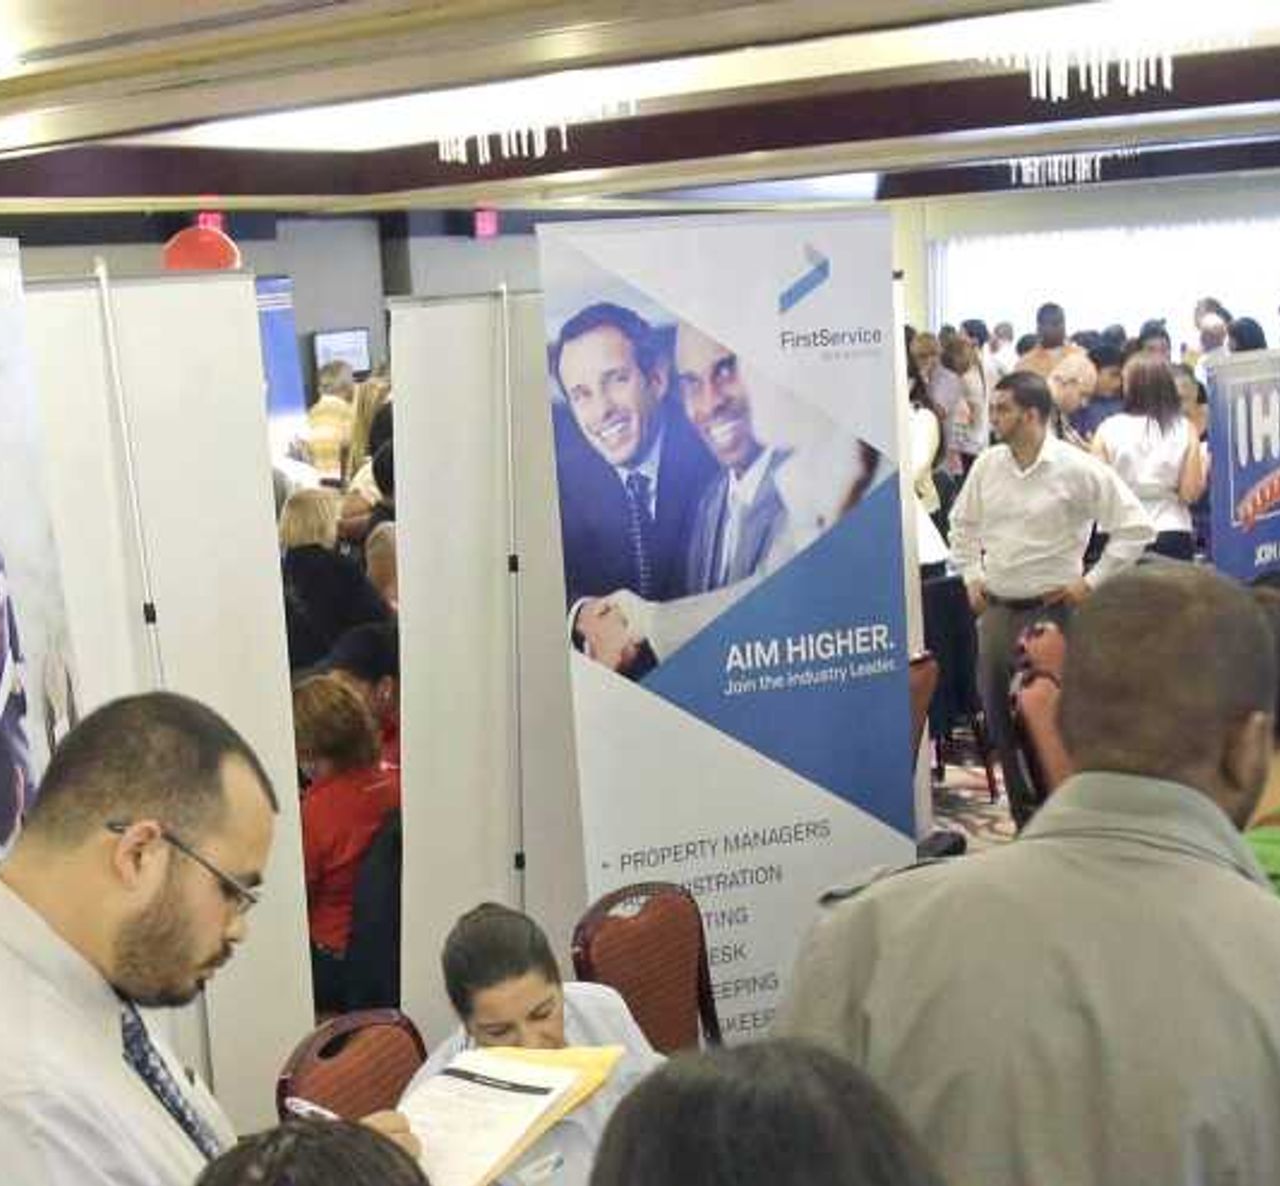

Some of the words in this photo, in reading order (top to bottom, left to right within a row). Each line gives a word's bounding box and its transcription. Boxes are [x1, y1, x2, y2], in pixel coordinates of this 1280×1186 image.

[781, 328, 882, 348] FirstService
[726, 639, 780, 674] AIM
[786, 624, 896, 663] HIGHER.
[724, 681, 757, 696] Join
[759, 676, 786, 692] the
[621, 840, 718, 872] PROPERTY
[723, 819, 832, 852] MANAGERS
[710, 942, 748, 965] ESK
